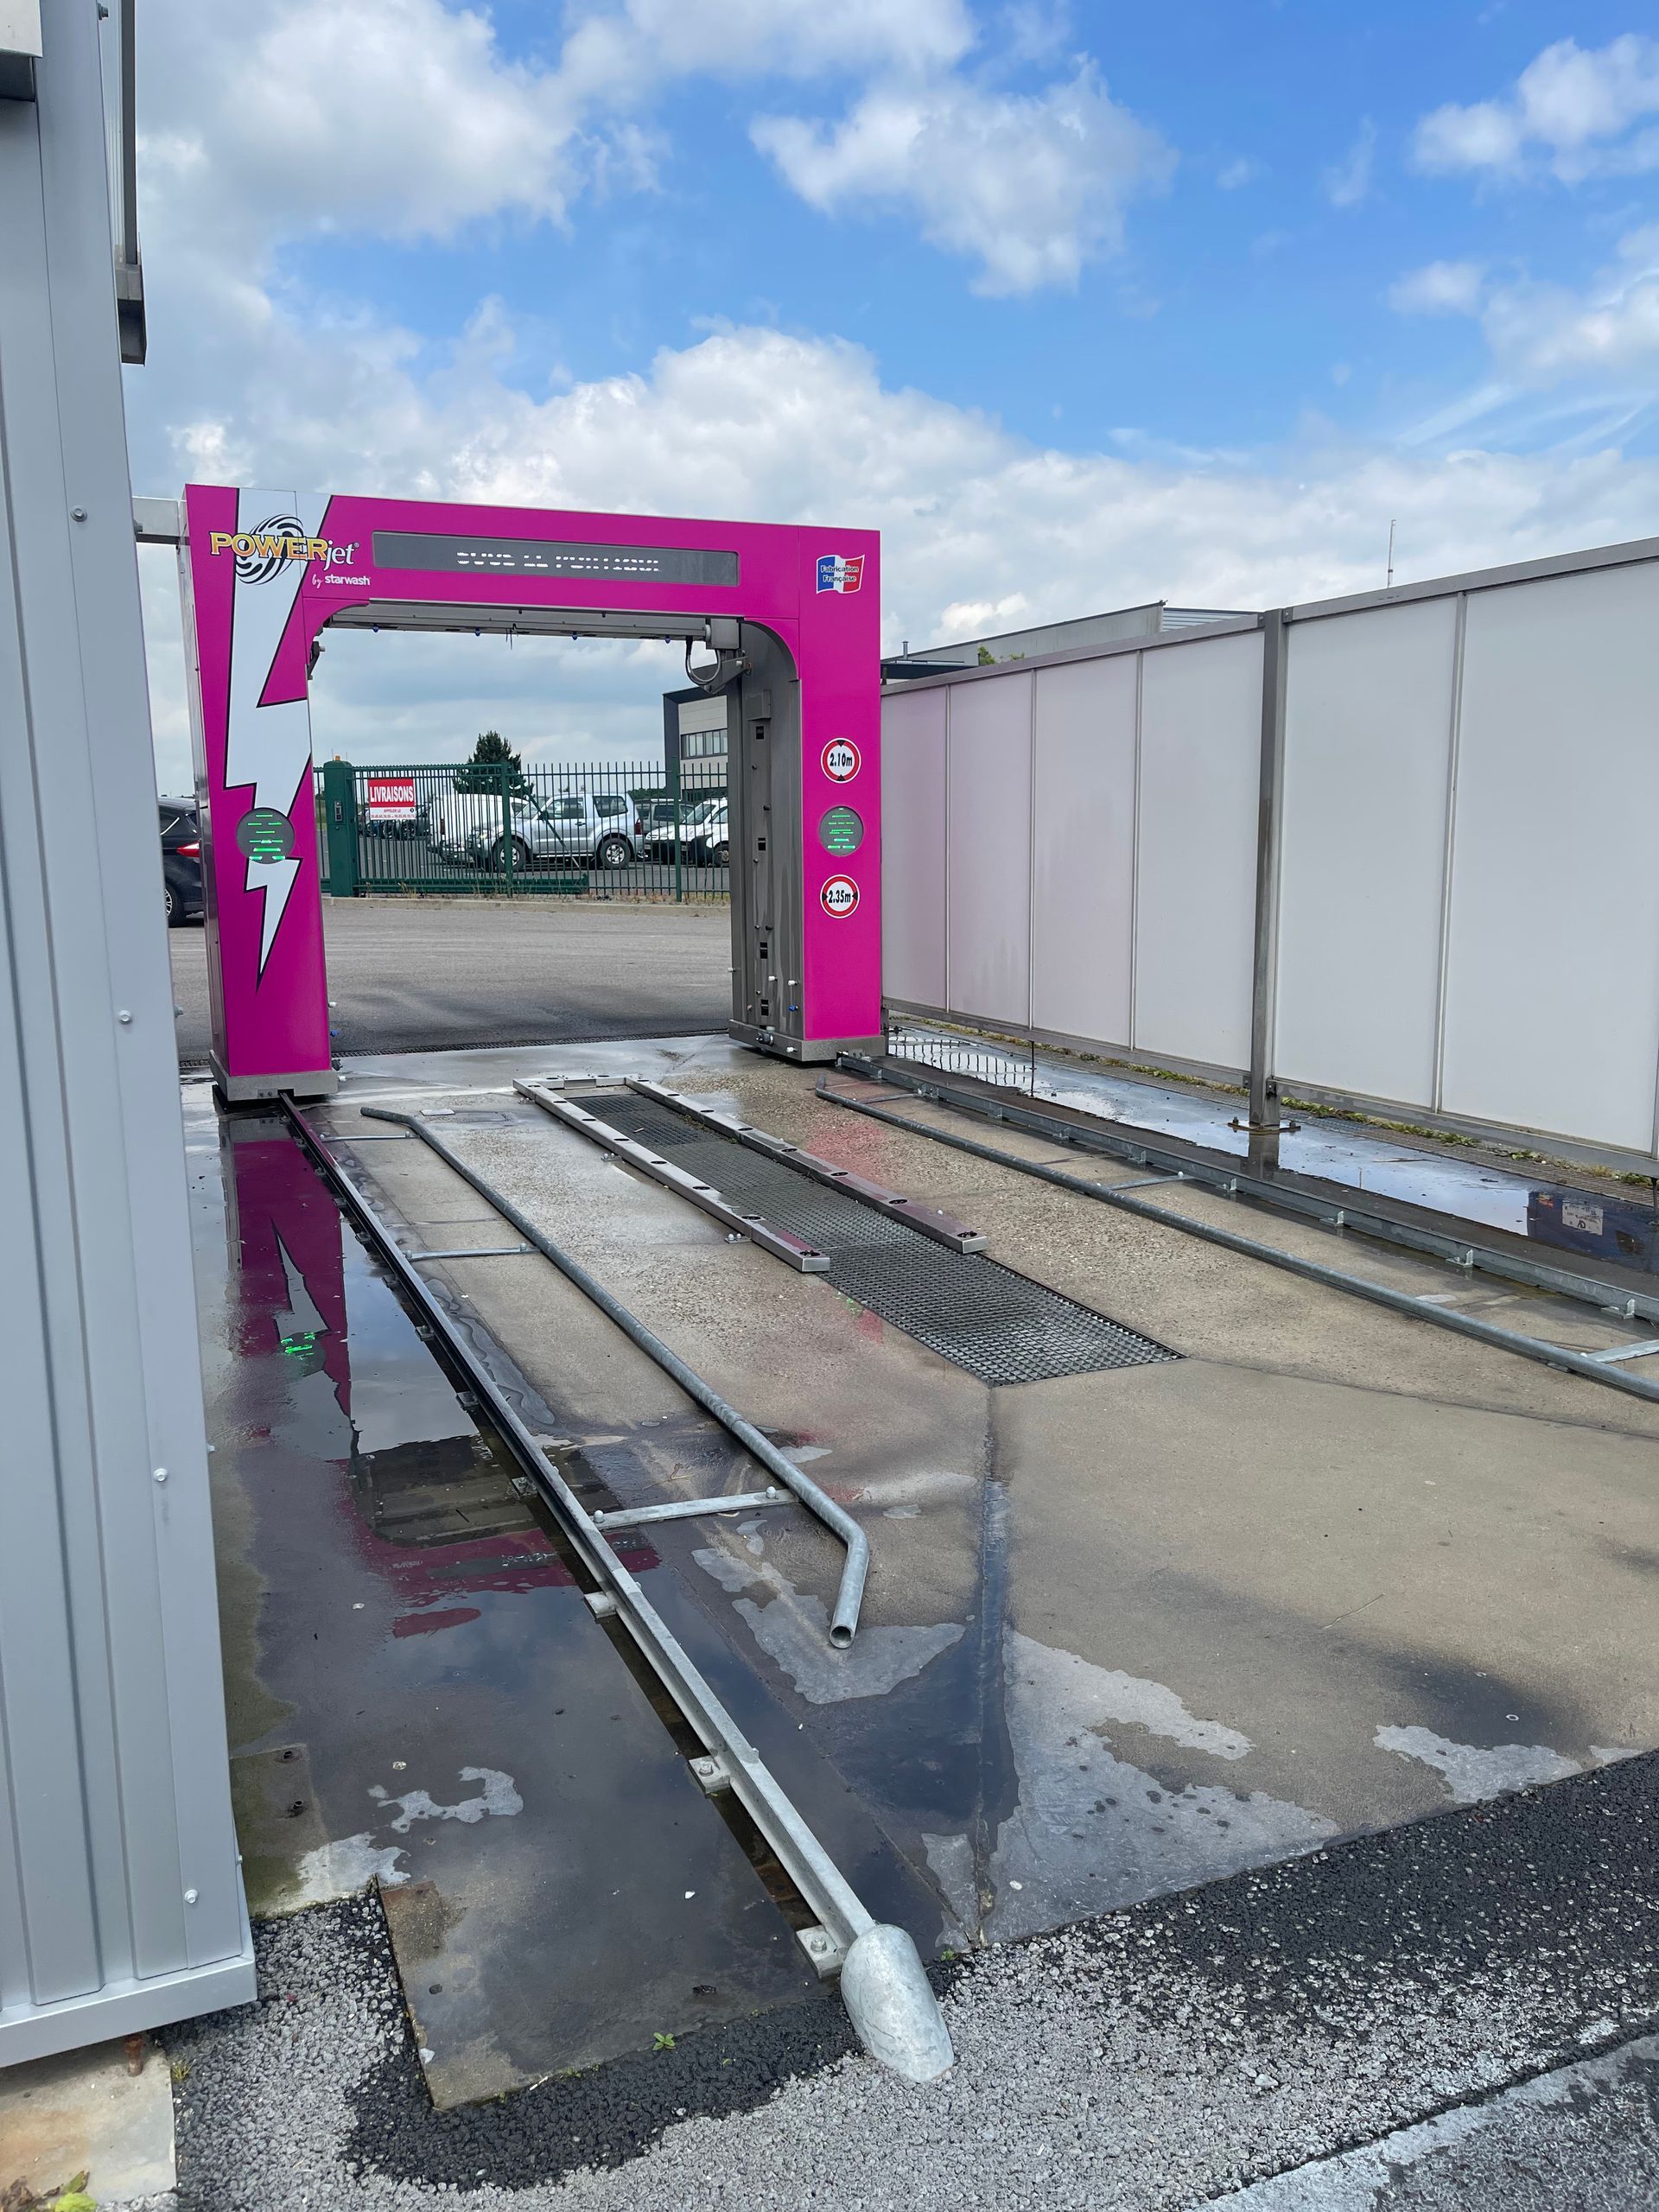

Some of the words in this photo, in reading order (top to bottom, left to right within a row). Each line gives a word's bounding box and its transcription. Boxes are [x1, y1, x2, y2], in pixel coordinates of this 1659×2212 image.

[312, 574, 322, 588] by
[325, 574, 371, 586] starwash
[823, 575, 857, 583] Française
[830, 753, 853, 767] 2.10m
[370, 785, 414, 803] LIVRAISONS
[828, 889, 851, 904] 2.35m
